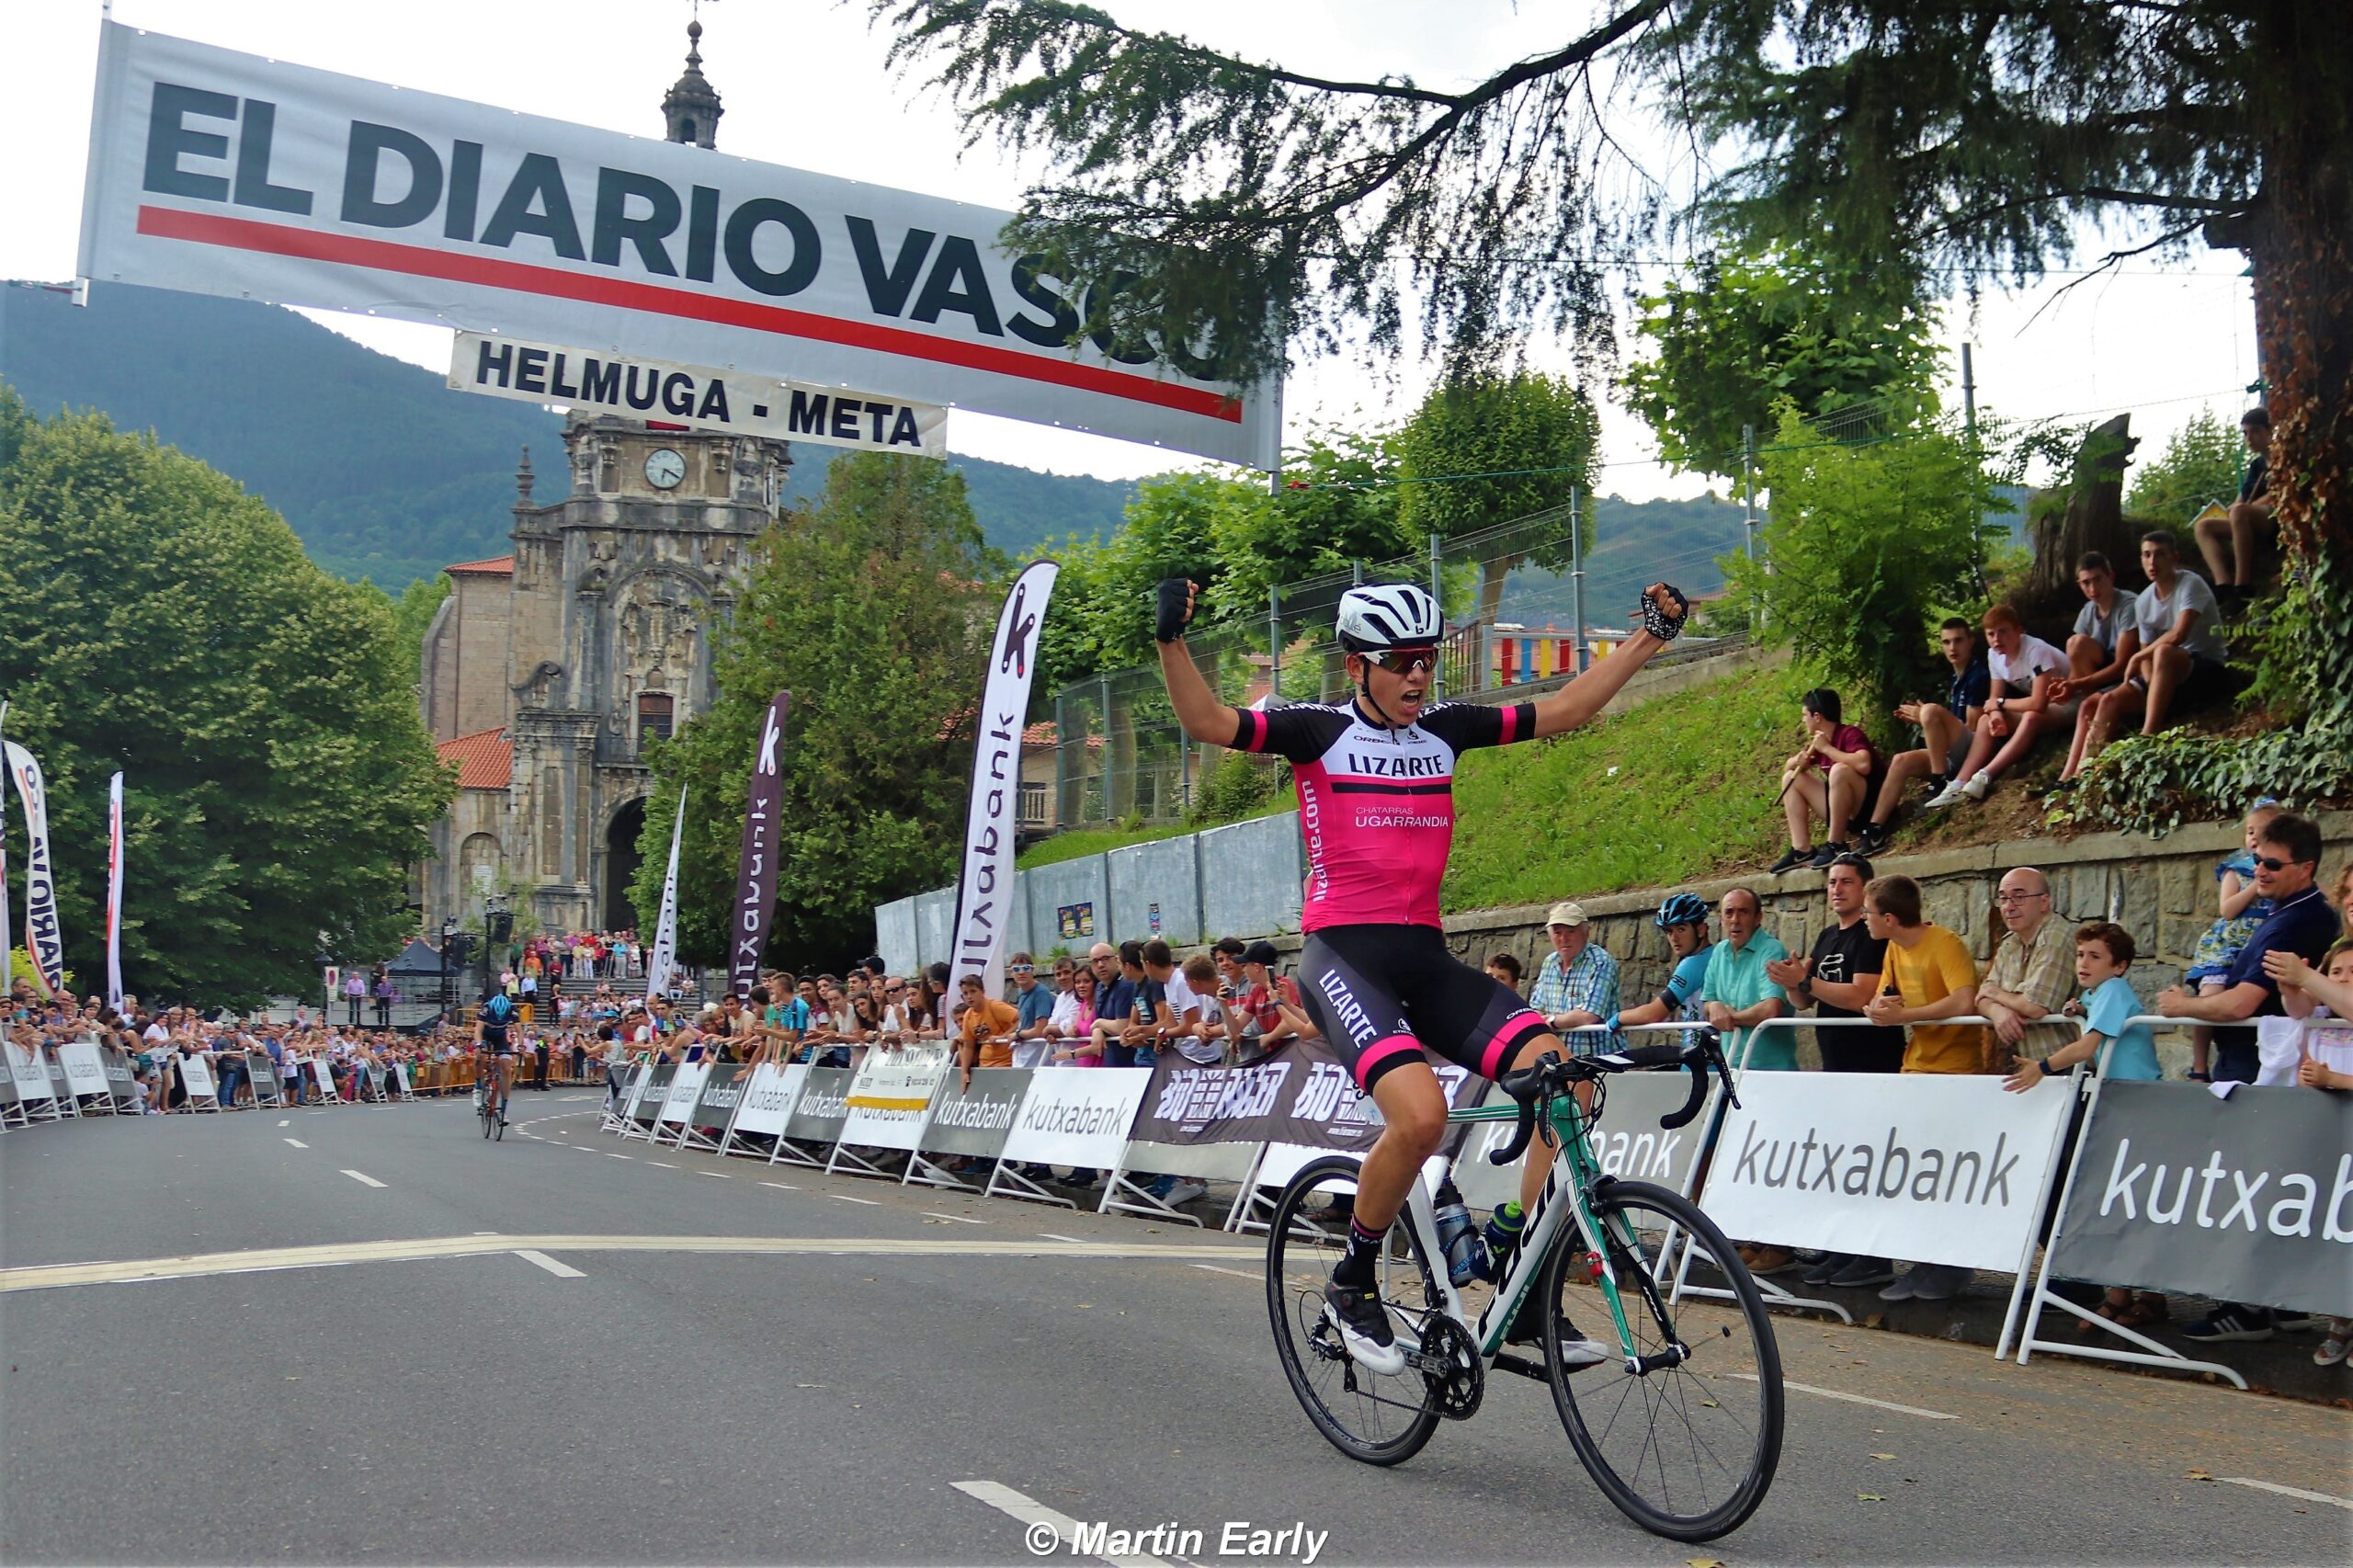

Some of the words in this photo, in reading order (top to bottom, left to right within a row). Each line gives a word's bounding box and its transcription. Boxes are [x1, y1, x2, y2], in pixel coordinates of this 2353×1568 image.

[142, 81, 313, 216] EL
[340, 119, 821, 296] DIARIO
[476, 341, 730, 423] HELMUGA
[789, 390, 922, 448] META
[1348, 753, 1445, 777] LIZARTE
[1302, 779, 1329, 903] lizarte.com
[1355, 816, 1449, 828] UGARRANDIA
[1356, 806, 1414, 815] CHATARRAS
[1318, 969, 1377, 1050] LIZARTE
[934, 1091, 1017, 1130] kutxabank
[1022, 1094, 1128, 1136] kutxabank
[1476, 1091, 1681, 1178] kubank
[1733, 1119, 2019, 1207] kutxabank
